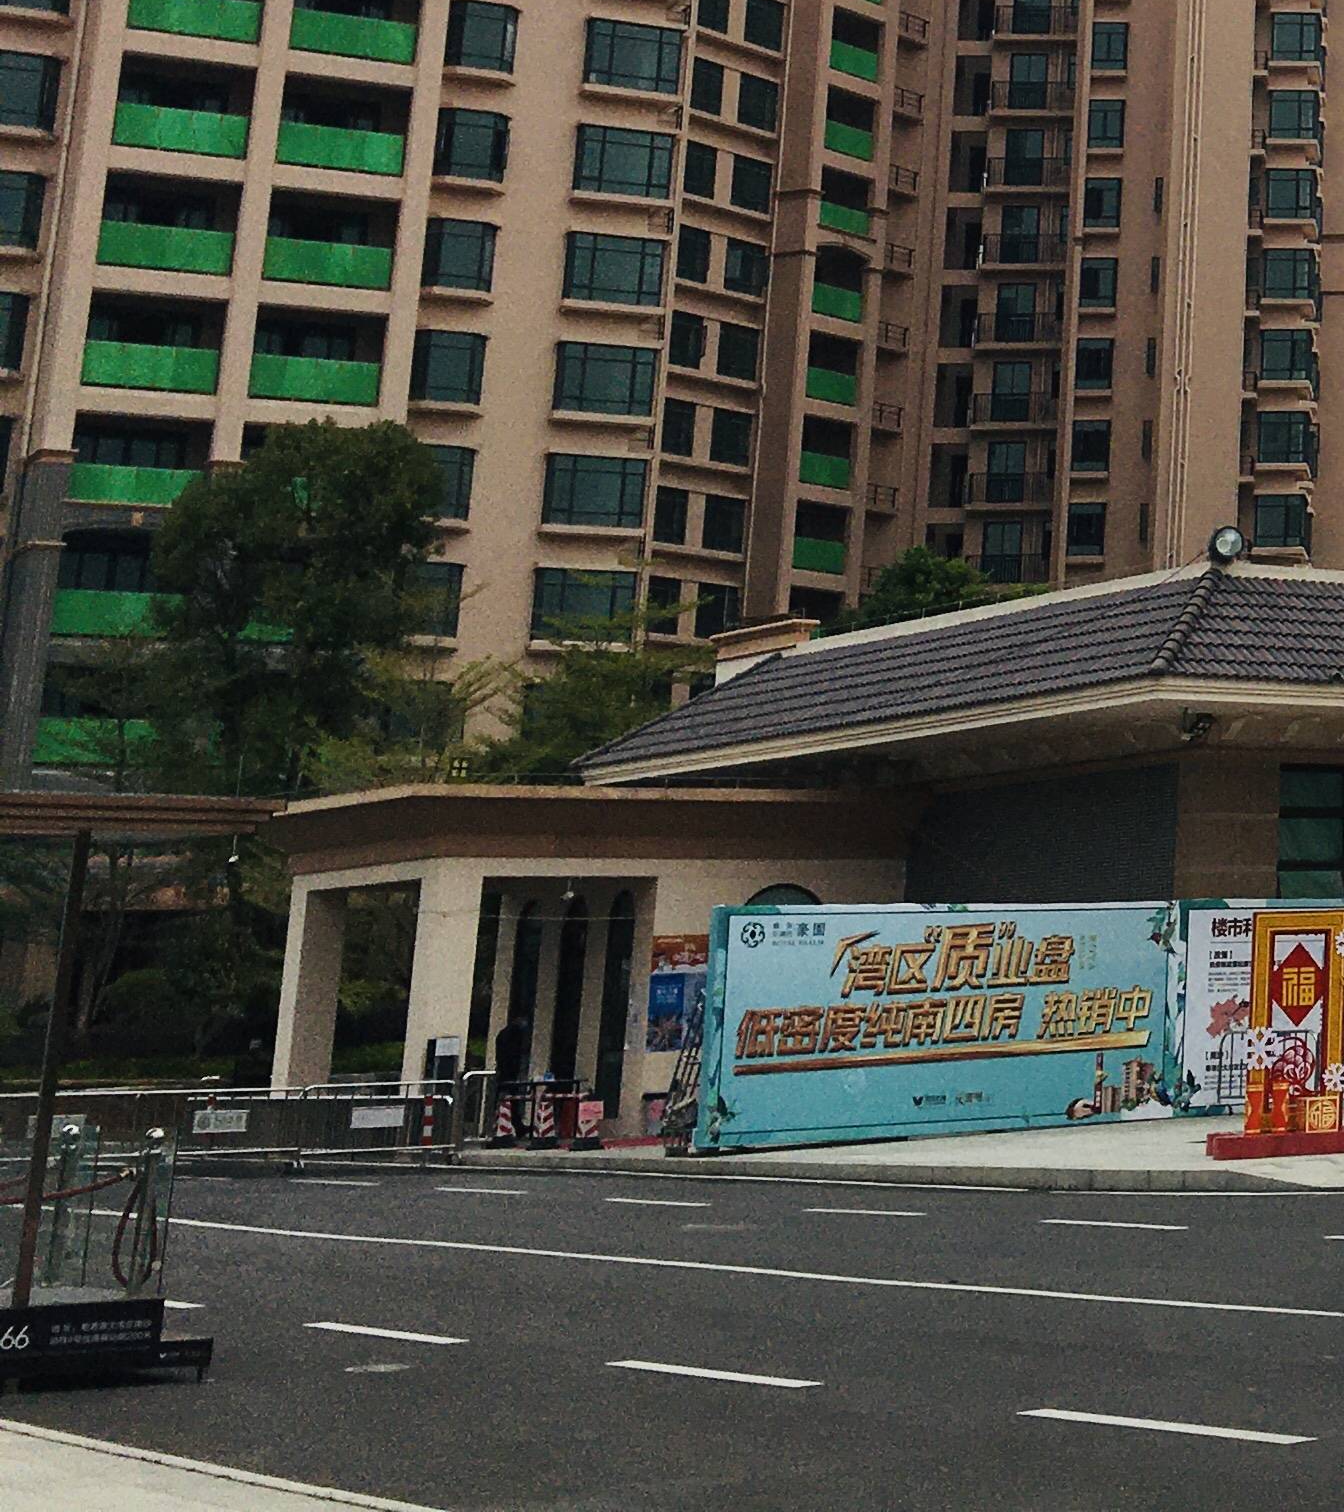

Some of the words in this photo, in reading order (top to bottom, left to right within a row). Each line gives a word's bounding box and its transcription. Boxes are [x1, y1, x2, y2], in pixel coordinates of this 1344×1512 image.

[1282, 966, 1316, 1006] 福
[735, 993, 1025, 1059] 低密度纯南四房
[1035, 985, 1154, 1040] 热销中
[1309, 1099, 1338, 1129] 福
[0, 1325, 30, 1350] 66
